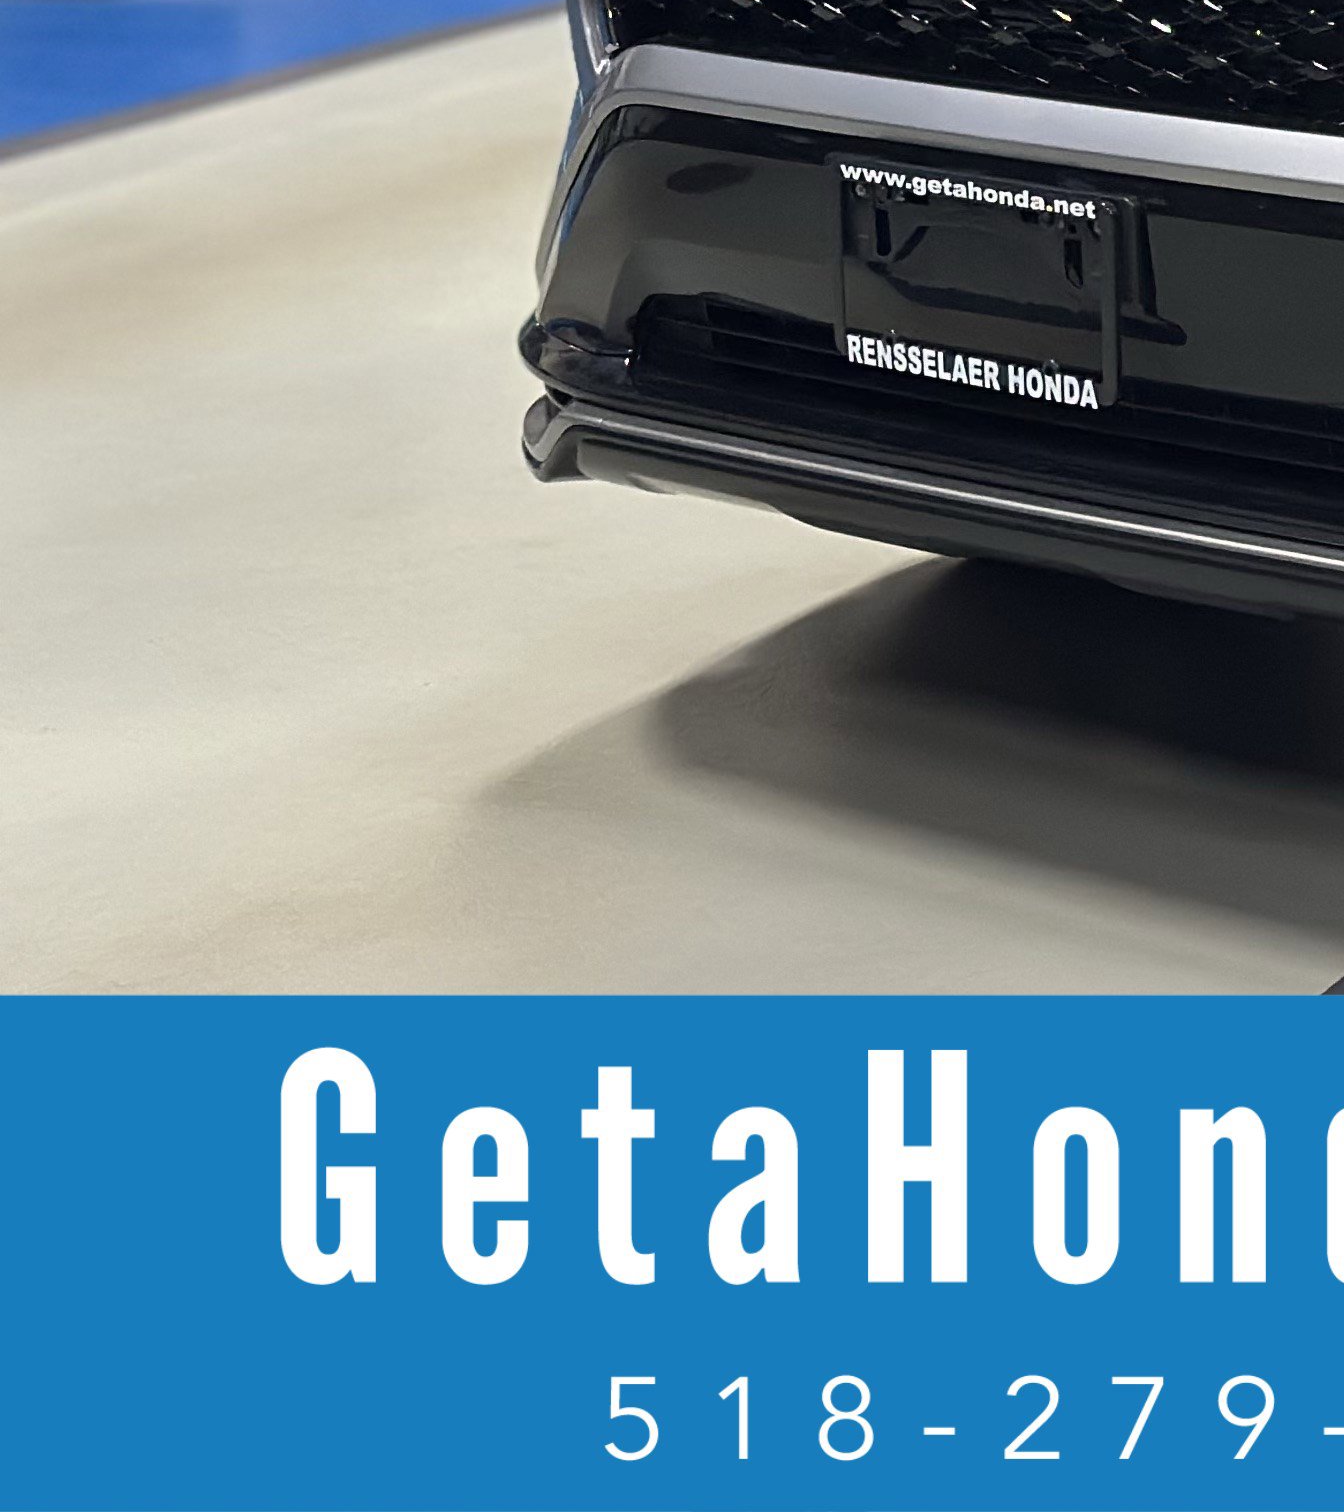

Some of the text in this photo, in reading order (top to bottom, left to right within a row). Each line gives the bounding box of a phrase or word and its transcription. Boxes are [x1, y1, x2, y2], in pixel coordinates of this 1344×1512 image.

[839, 164, 1096, 219] www.getahonda.net
[846, 333, 1099, 410] RENSSELAER HONDA
